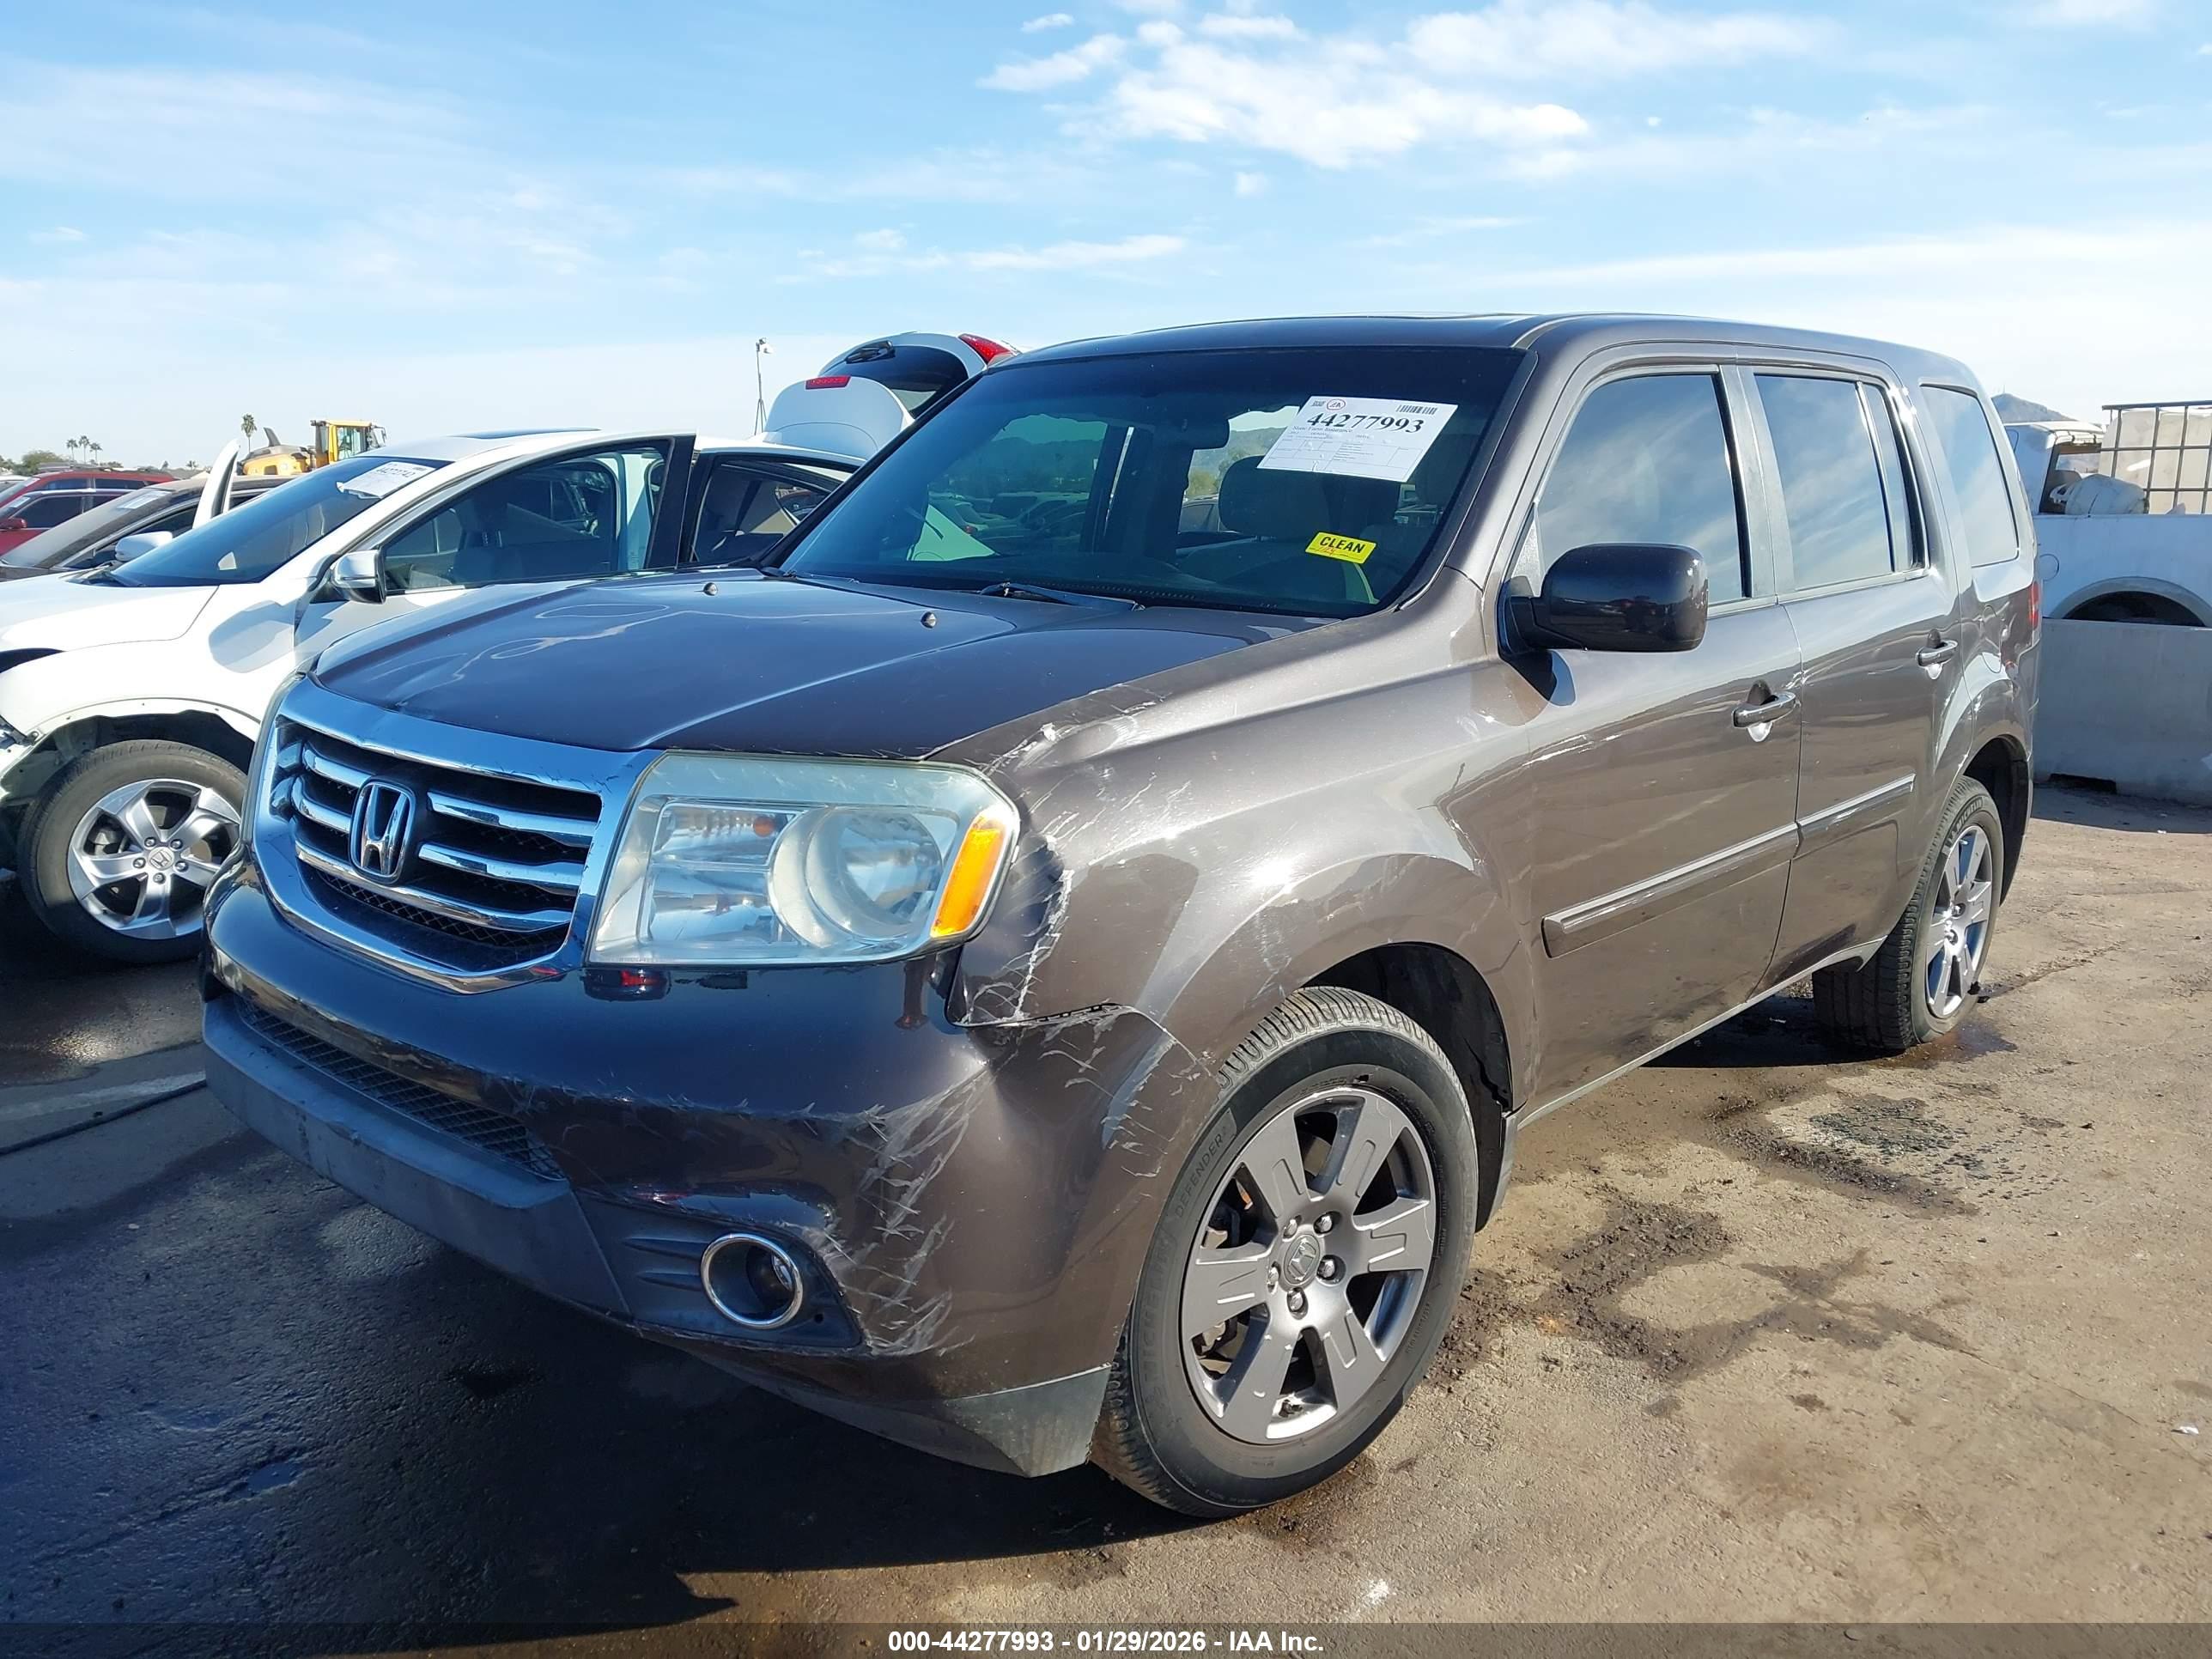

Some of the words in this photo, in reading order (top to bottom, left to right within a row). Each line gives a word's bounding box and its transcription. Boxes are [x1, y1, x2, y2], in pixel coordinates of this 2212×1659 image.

[1307, 412, 1424, 433] 44277993
[1320, 537, 1365, 553] CLEAN
[1175, 1133, 1224, 1218] DEFENDER
